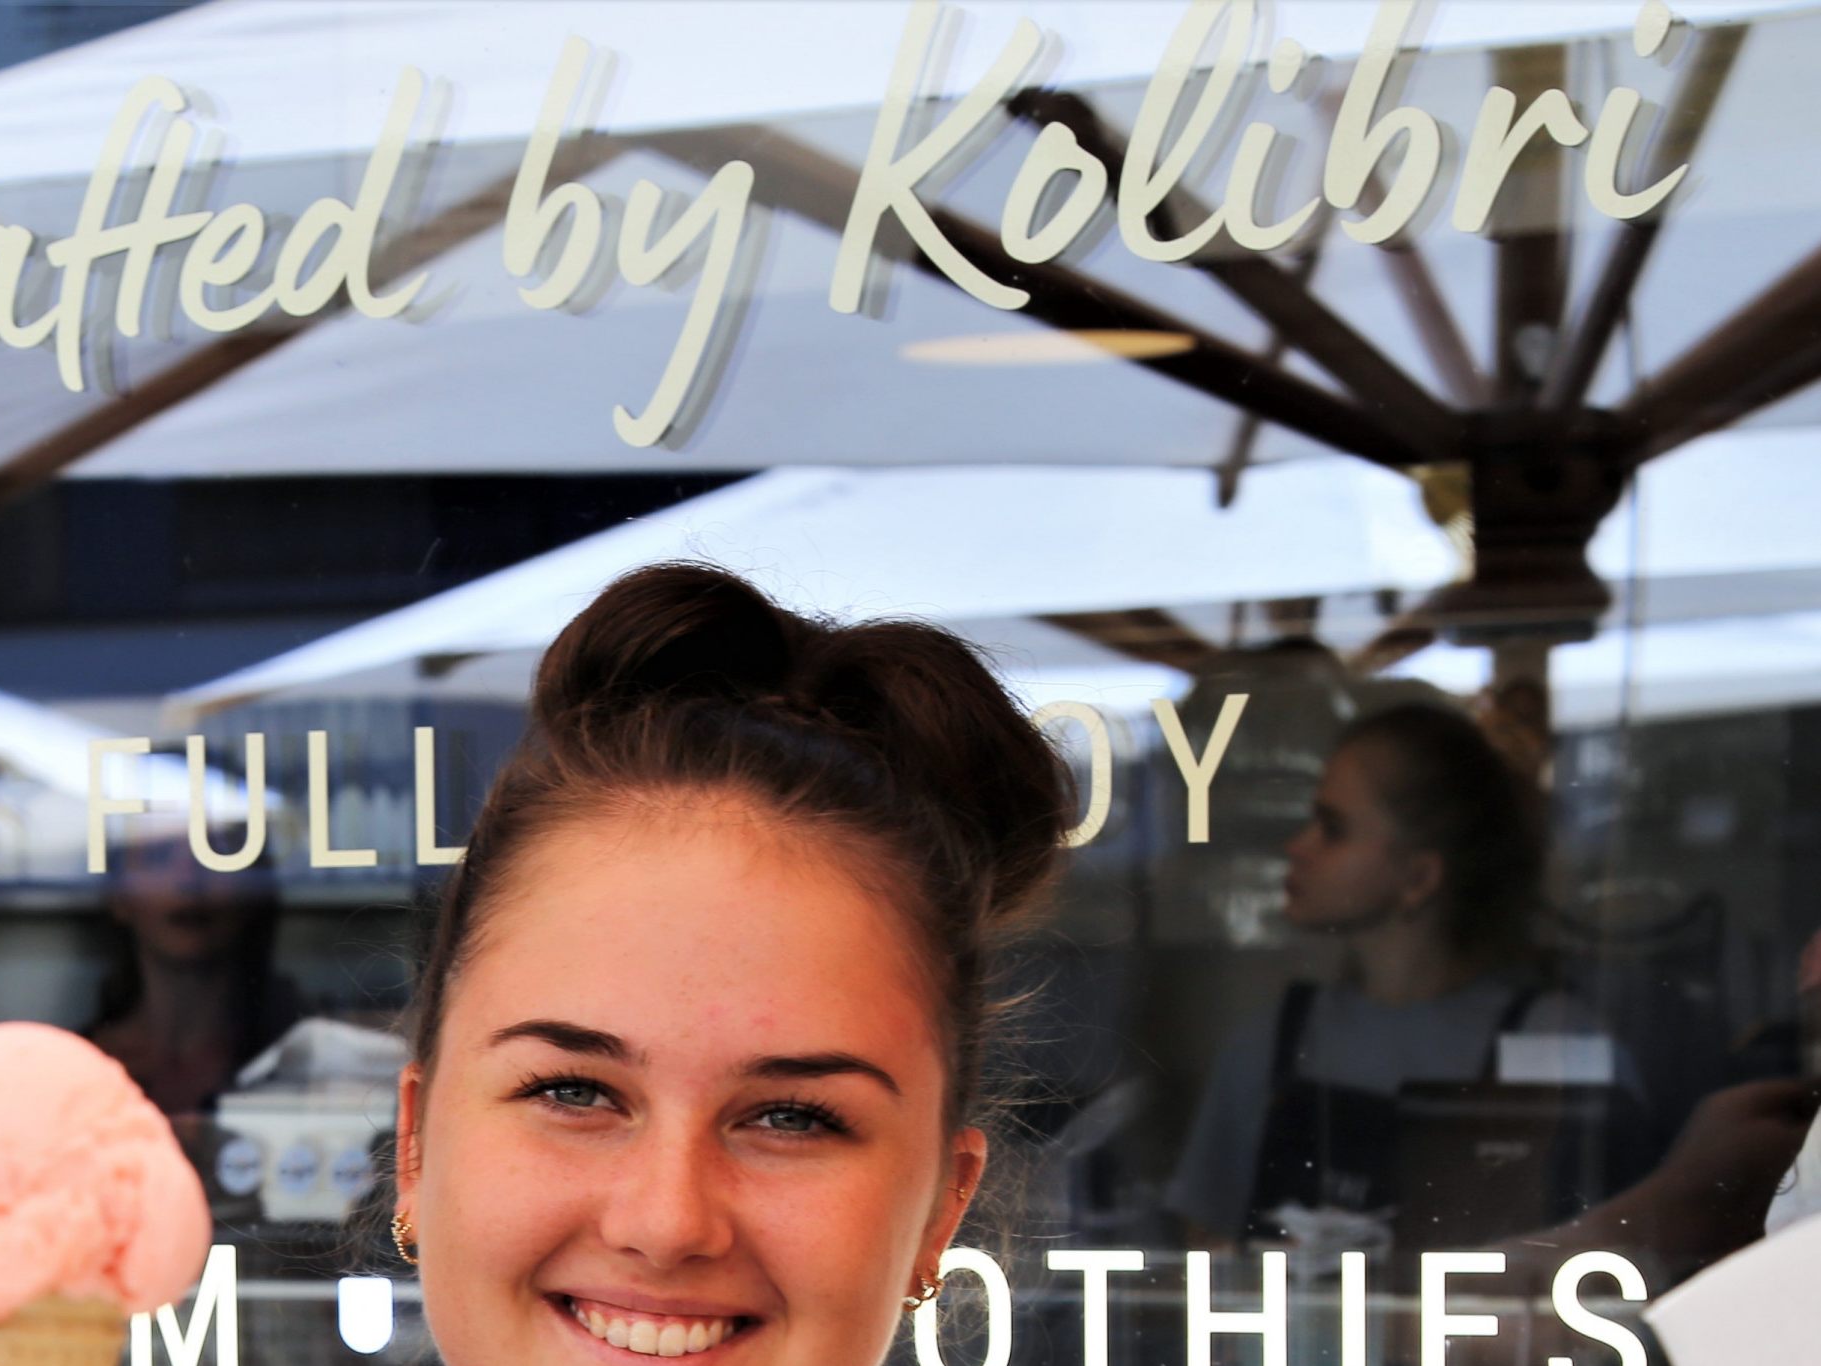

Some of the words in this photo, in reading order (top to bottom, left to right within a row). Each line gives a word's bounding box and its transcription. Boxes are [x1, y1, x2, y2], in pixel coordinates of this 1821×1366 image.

[503, 35, 755, 447] by
[829, 0, 1688, 313] Kolibri
[86, 727, 468, 874] FULL
[1030, 693, 1249, 849] OY
